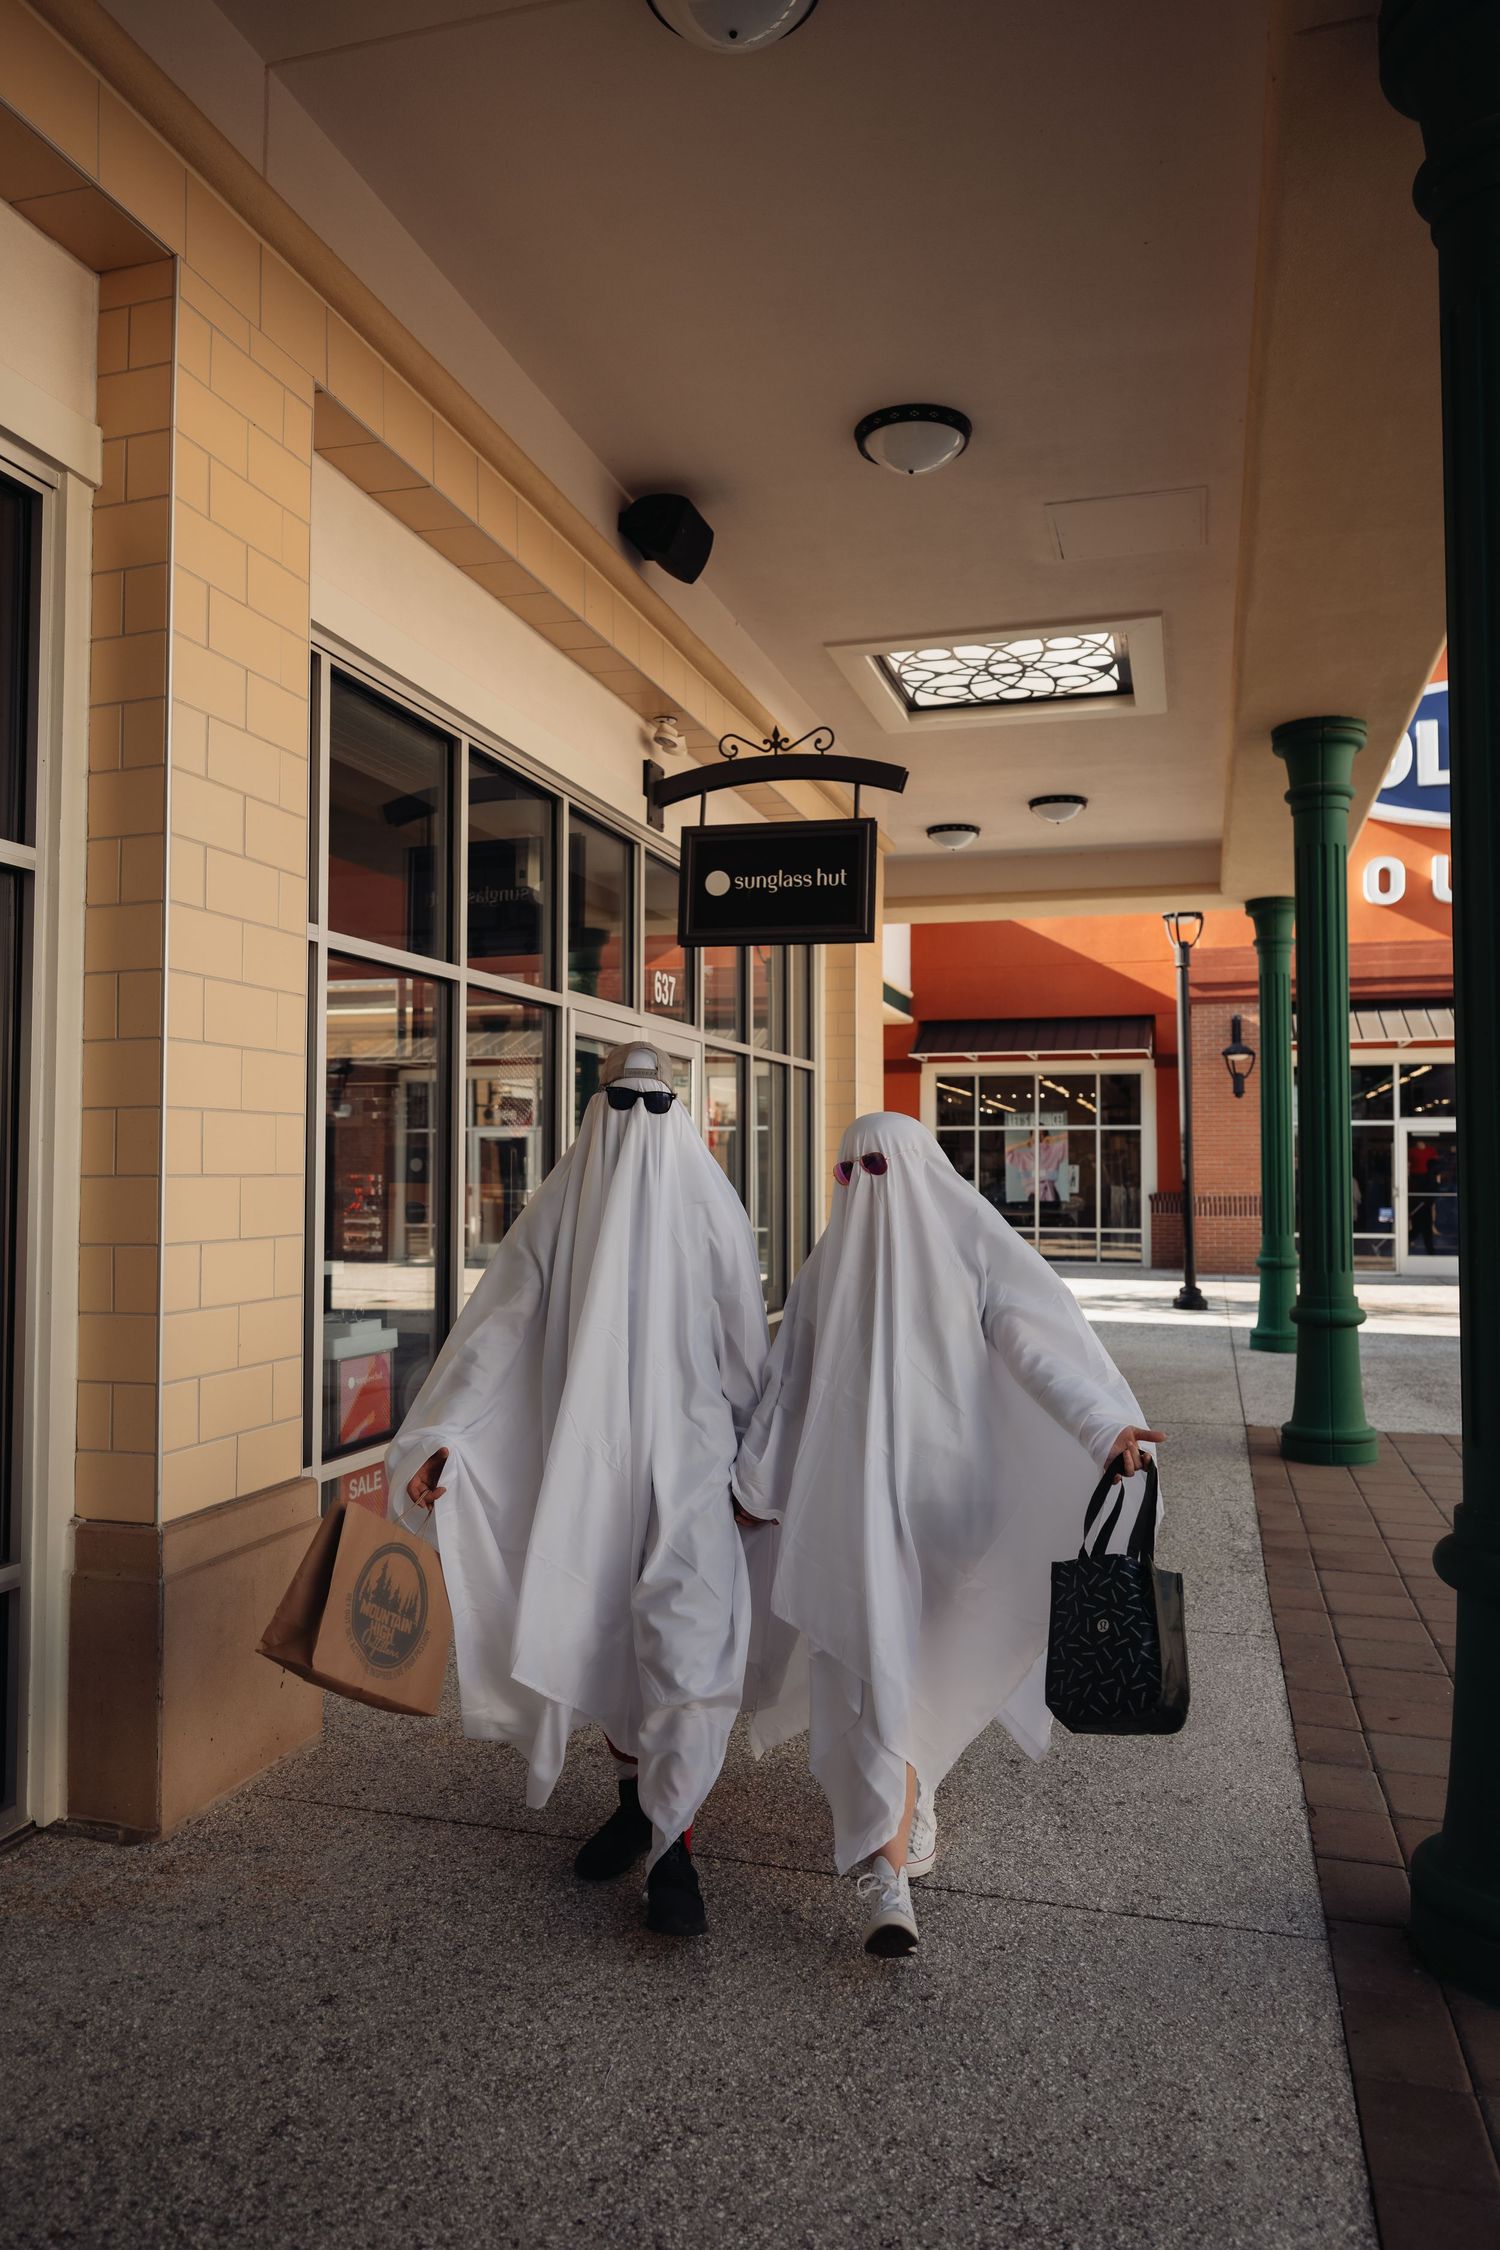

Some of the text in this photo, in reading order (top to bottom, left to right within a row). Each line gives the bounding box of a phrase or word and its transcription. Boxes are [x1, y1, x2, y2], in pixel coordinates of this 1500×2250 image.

[735, 868, 847, 893] sunglass hut
[654, 970, 676, 1007] 637
[349, 1470, 382, 1500] SALE
[360, 1599, 413, 1634] MOUNTAIN
[370, 1620, 395, 1644] HIGH
